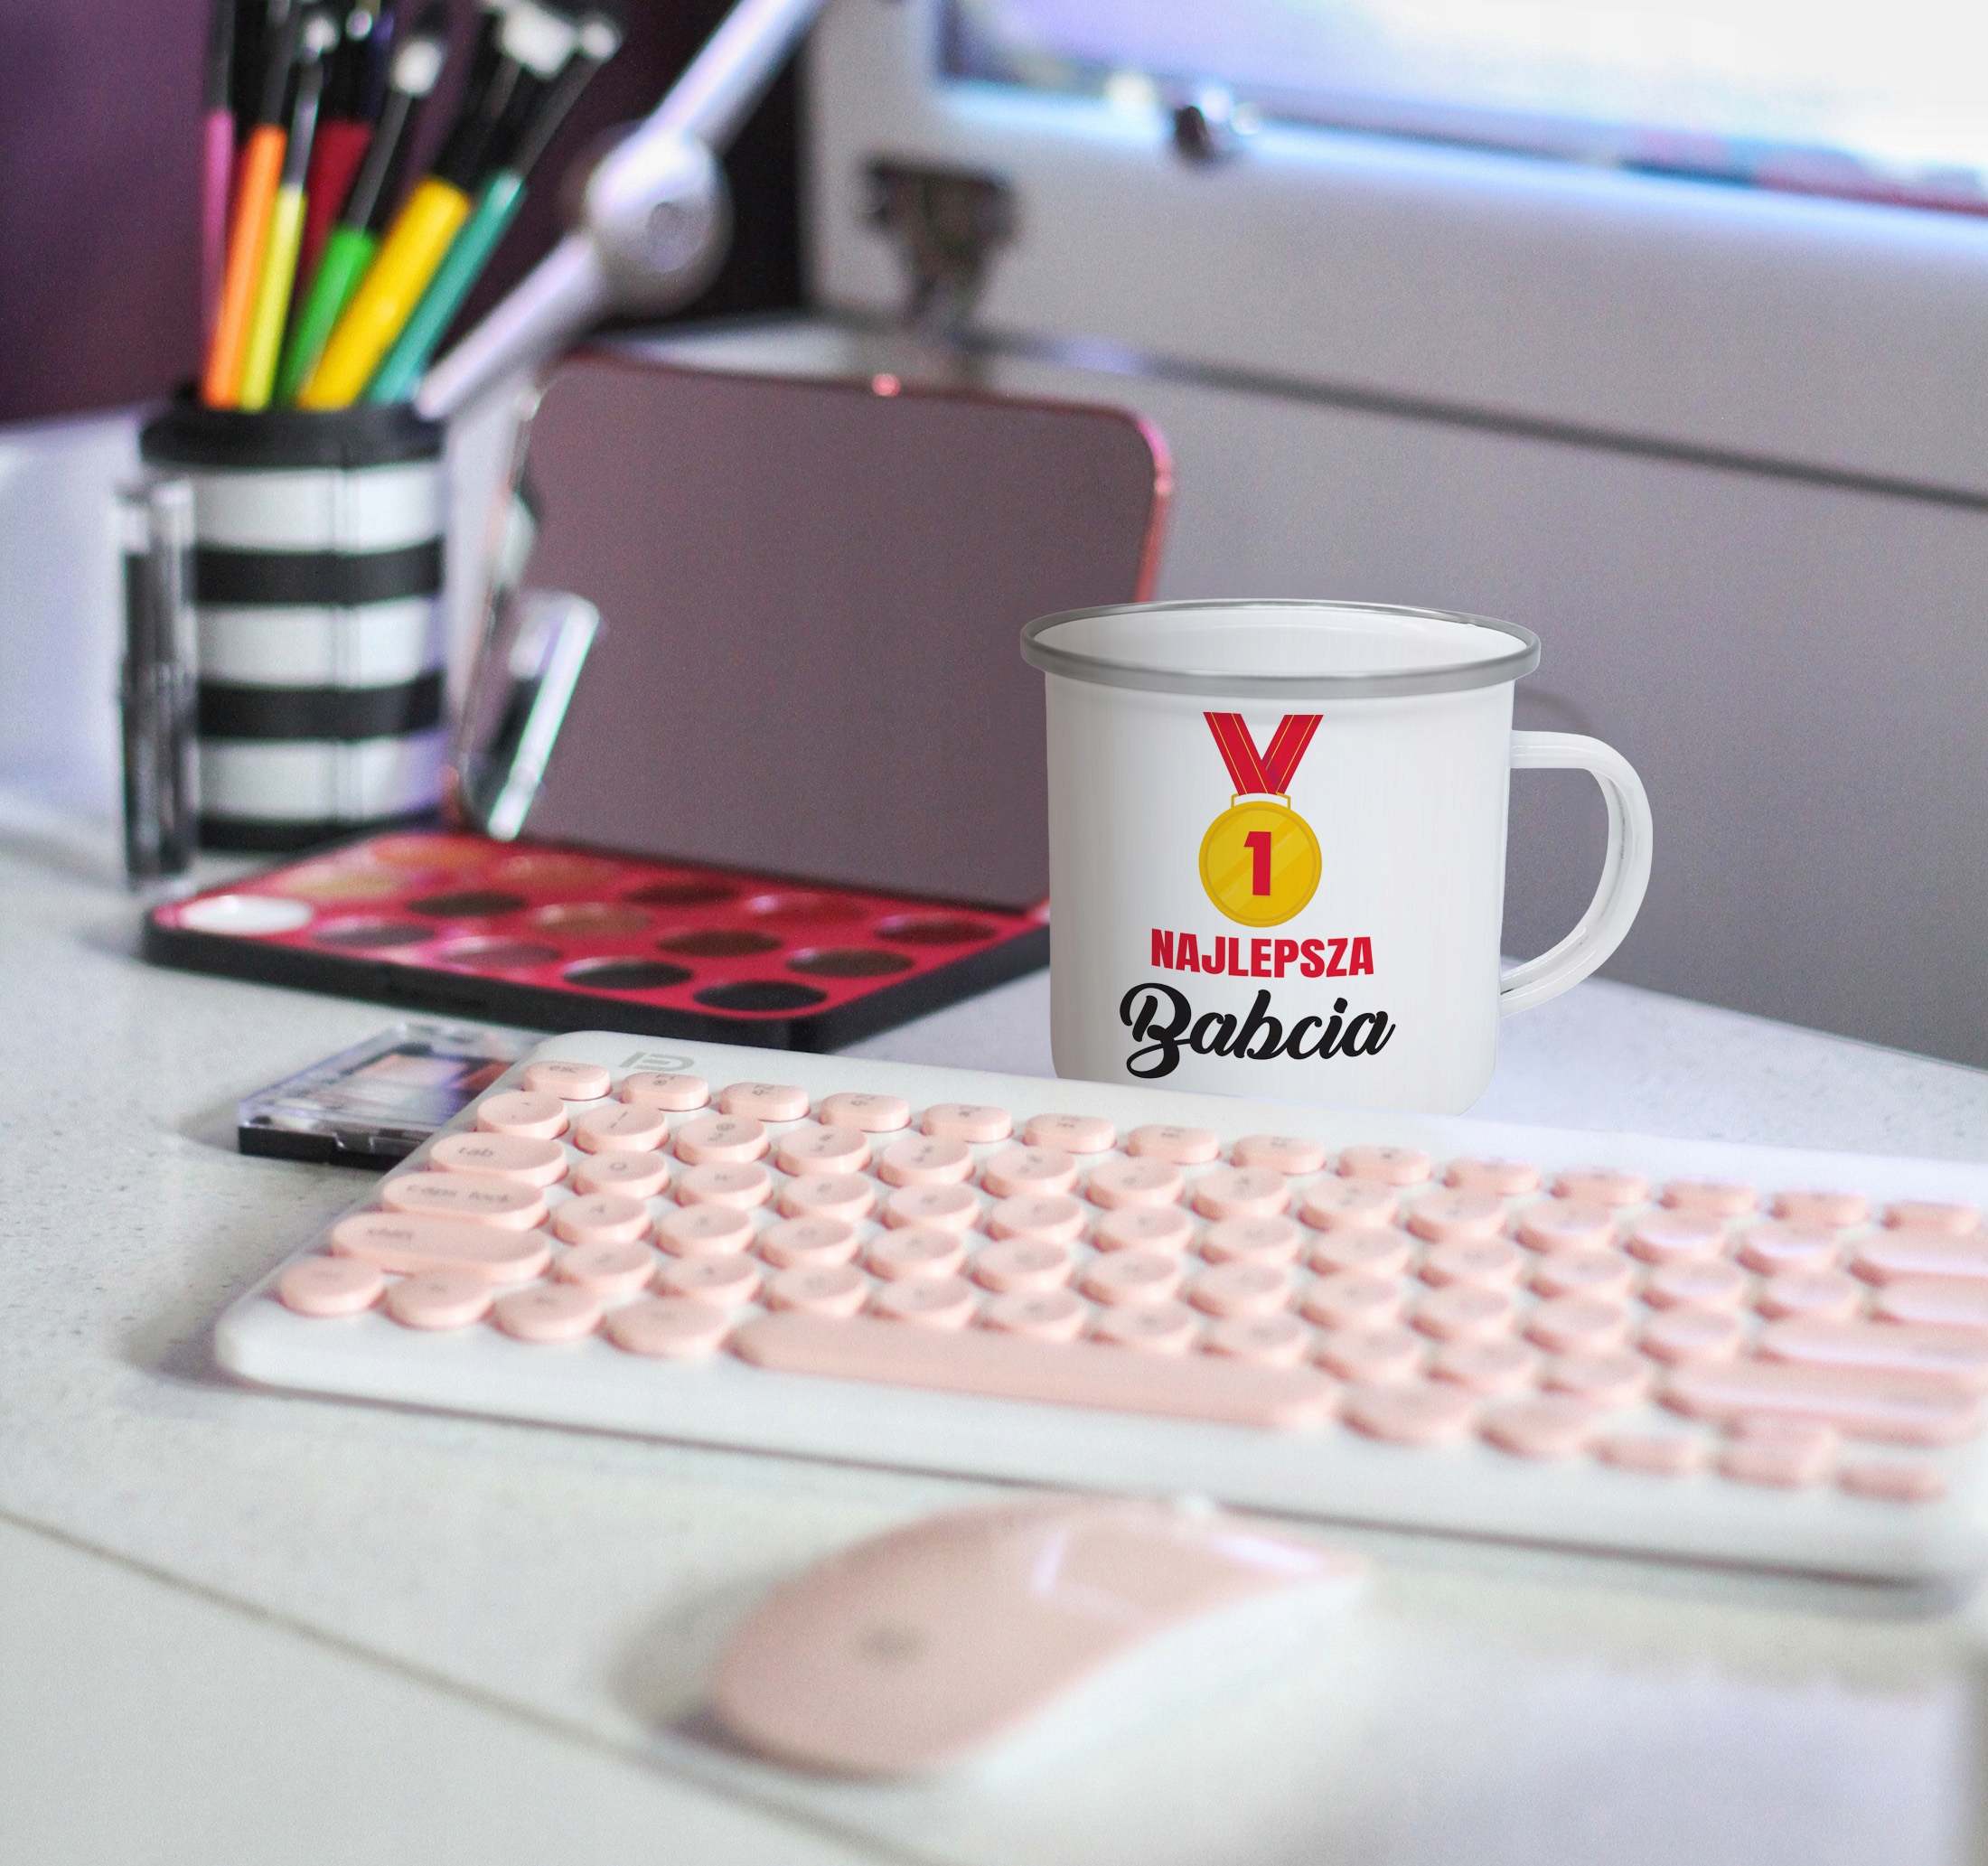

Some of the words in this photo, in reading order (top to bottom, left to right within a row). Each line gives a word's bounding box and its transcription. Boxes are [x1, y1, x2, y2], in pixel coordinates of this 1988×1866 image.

[1243, 830, 1272, 896] 1
[1150, 928, 1374, 979] NAJLEPSZA
[1119, 982, 1396, 1079] Babcia
